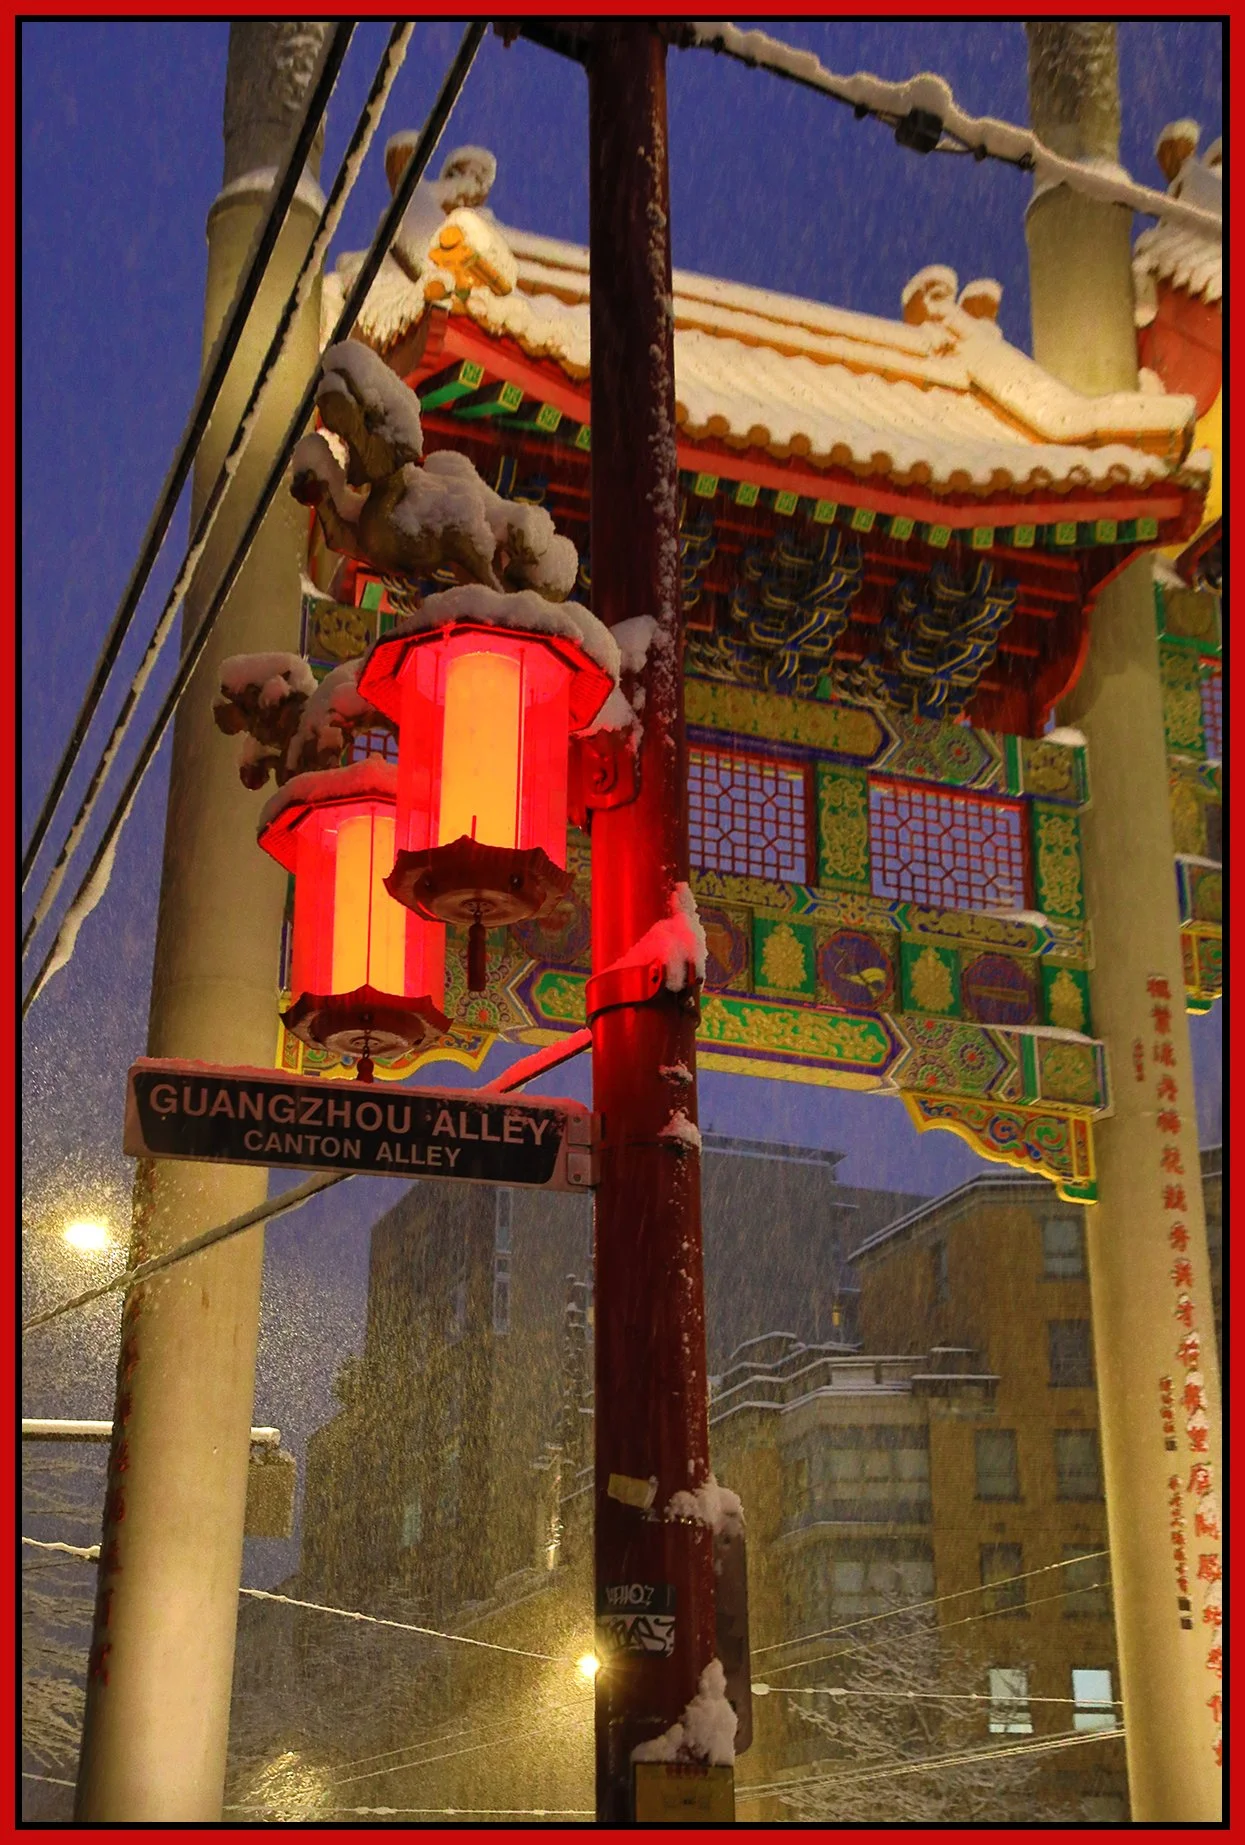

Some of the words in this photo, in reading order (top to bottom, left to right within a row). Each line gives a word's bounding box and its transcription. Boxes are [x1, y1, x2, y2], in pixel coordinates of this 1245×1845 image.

[149, 1083, 412, 1135] GUANGZHOU
[431, 1109, 550, 1146] ALLEY
[244, 1129, 361, 1160] CANTON
[375, 1141, 462, 1168] ALLEY
